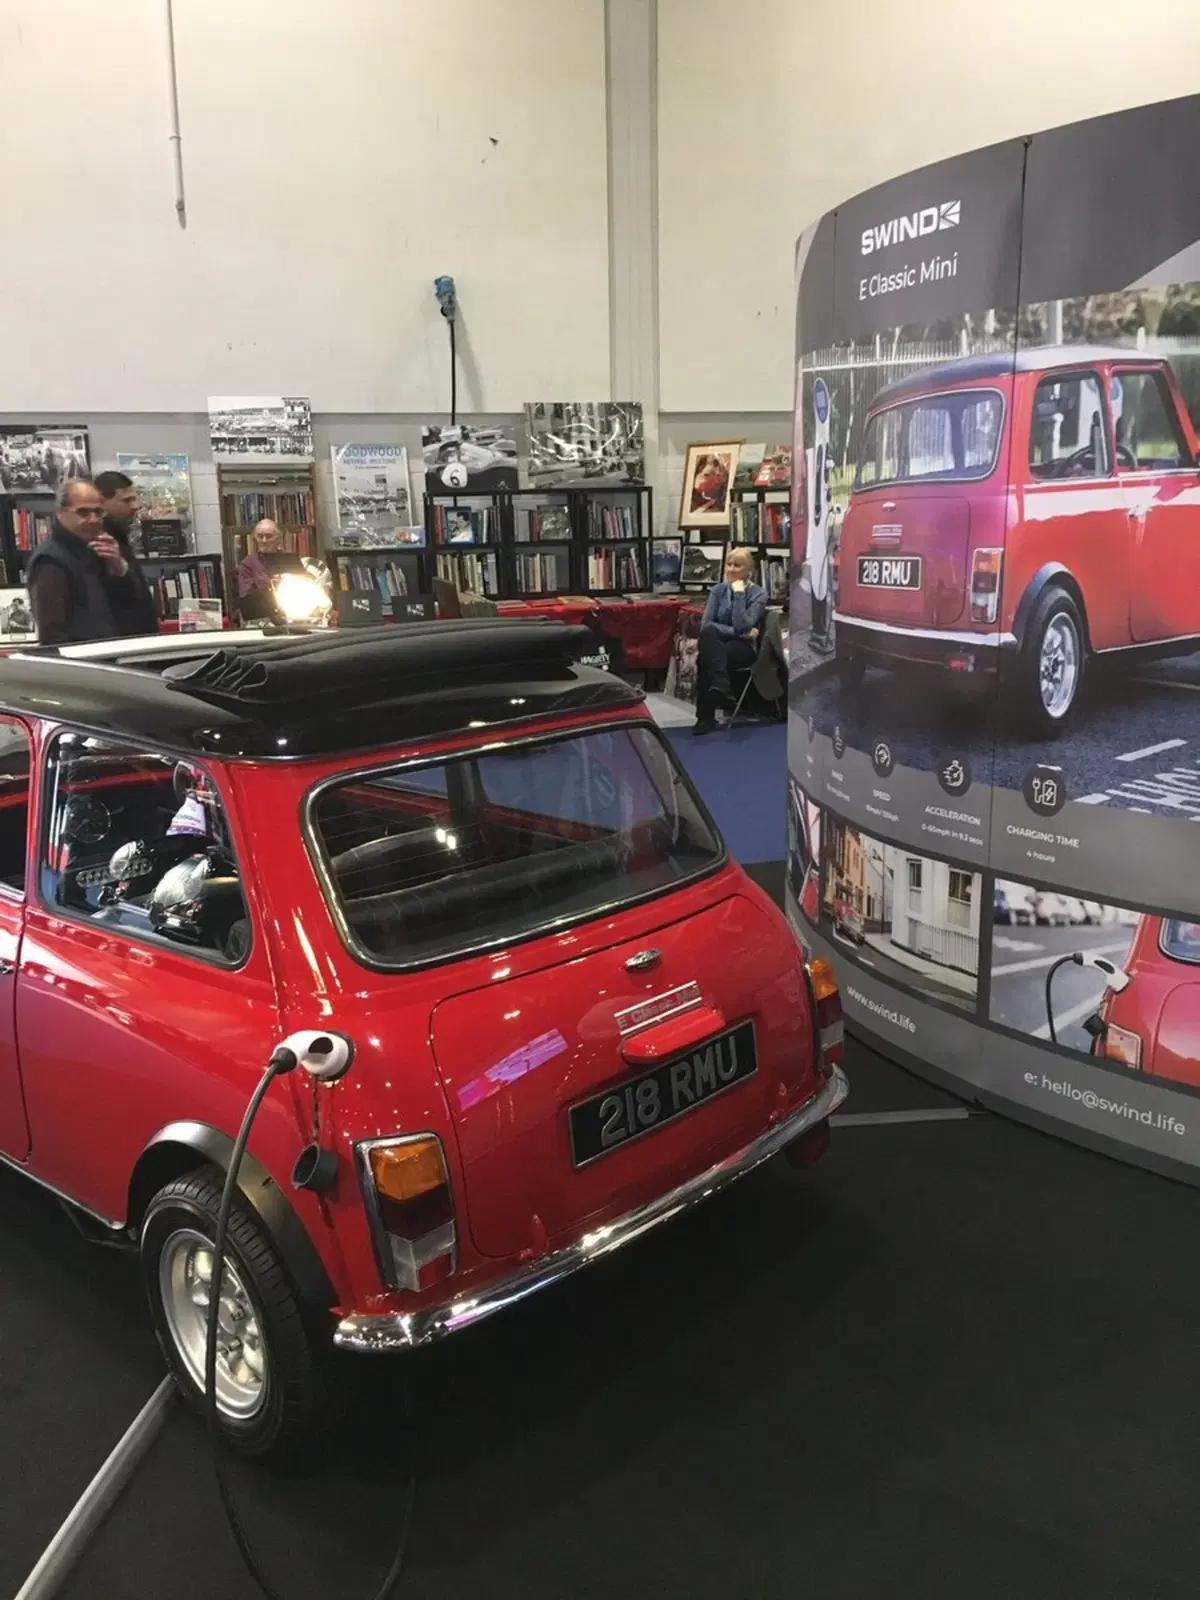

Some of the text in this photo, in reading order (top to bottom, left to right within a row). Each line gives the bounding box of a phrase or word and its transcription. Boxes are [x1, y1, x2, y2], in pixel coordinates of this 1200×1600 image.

[861, 206, 939, 255] SWIND
[859, 251, 959, 301] E Classic Mini
[450, 468, 460, 486] 6
[862, 560, 912, 586] 218 RMU
[924, 805, 981, 826] ACCELERATION
[1006, 825, 1081, 849] CHARGING TIME
[1026, 850, 1056, 863] 4 hours
[846, 984, 917, 1033] www.swind.life
[599, 1035, 738, 1147] 218 RMU
[1024, 1071, 1186, 1136] e: hello@swind.life
